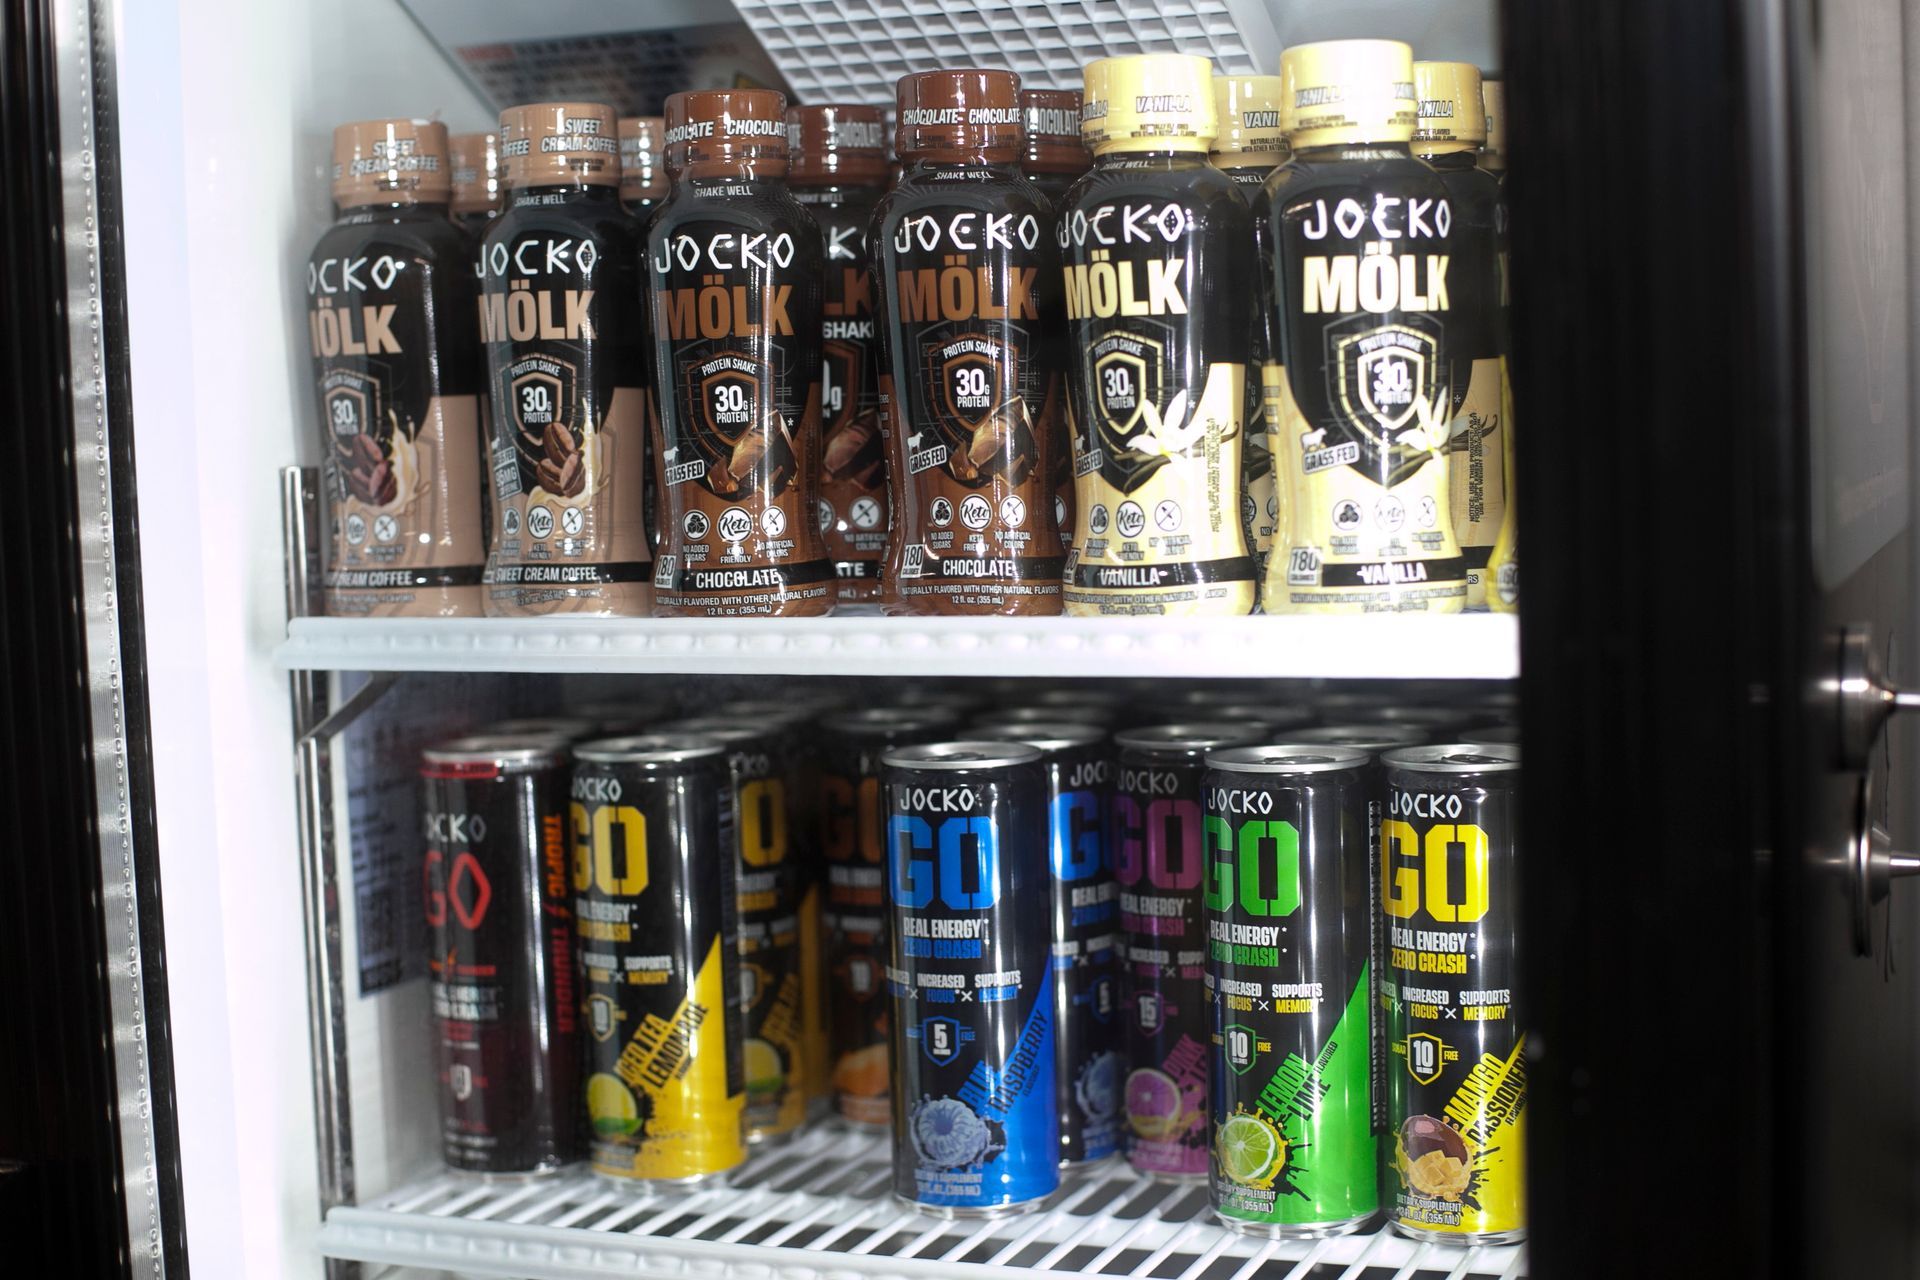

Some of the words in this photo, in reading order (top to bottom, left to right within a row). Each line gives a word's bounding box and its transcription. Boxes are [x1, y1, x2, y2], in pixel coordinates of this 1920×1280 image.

[1136, 95, 1192, 113] VANILLA
[1417, 101, 1453, 117] ANILLA
[565, 118, 602, 134] SWEET
[903, 109, 959, 125] CHOCOLATE
[969, 108, 1021, 124] CHOCOLATE
[541, 136, 583, 153] CREAM
[585, 136, 617, 154] COFFEE
[1126, 161, 1149, 169] WELL
[935, 172, 964, 180] SHAKE
[966, 171, 994, 179] WELL
[514, 196, 541, 207] SHAKE
[542, 194, 566, 205] WELL
[694, 187, 725, 198] SHAKE
[726, 185, 753, 196] WELL
[1060, 203, 1185, 248] JOCKO
[1303, 197, 1451, 240] JOCKO
[895, 213, 1039, 253] JOCKO
[474, 239, 598, 278] JOCKO
[655, 233, 795, 274] JOCKO
[1064, 249, 1188, 321] MÖLK
[1303, 241, 1449, 313] MÖLK
[897, 254, 1039, 323] MÖLK
[478, 279, 597, 344] MÖLK
[657, 274, 795, 341] MÖLK
[823, 321, 874, 339] SHAK
[943, 341, 974, 359] PROTEIN
[975, 341, 1001, 359] SHAKE
[1095, 338, 1118, 357] PROTEIN
[1119, 339, 1143, 355] SHAKE
[511, 360, 538, 377] PROTEIN
[539, 360, 561, 376] SHAKE
[701, 358, 732, 376] PROTEIN
[733, 358, 757, 375] SHAKE
[957, 395, 990, 408] PROTEIN
[1107, 396, 1135, 409] PROTEIN
[523, 411, 552, 424] PROTEIN
[717, 411, 749, 423] PROTEIN
[910, 453, 931, 472] GRASS
[931, 448, 946, 465] FED
[1305, 451, 1334, 471] GRASS
[1335, 445, 1356, 461] FED
[687, 463, 704, 480] FED
[962, 504, 992, 525] Keto
[1118, 509, 1142, 531] Keto
[530, 517, 553, 533] Keto
[721, 516, 752, 536] Keto
[937, 532, 954, 540] ADDED
[968, 534, 984, 543] KETO
[684, 553, 706, 562] SUGARS
[690, 545, 710, 553] ADDED
[905, 546, 922, 566] 180
[658, 556, 674, 576] 180
[720, 555, 752, 564] FRIENDLY
[943, 559, 1014, 577] CHOCOLATE
[368, 571, 413, 586] COFFEE
[496, 567, 523, 582] SWEET
[524, 566, 560, 581] CREAM
[561, 566, 599, 581] COFFEE
[696, 568, 781, 589] CHOCOLATE
[1100, 567, 1161, 586] VANILLA
[683, 596, 720, 606] FLAVORED
[721, 596, 741, 605] WITH
[743, 594, 769, 605] OTHER
[770, 591, 802, 603] NATURAL
[803, 587, 827, 599] FLAVORS
[934, 585, 962, 594] FLAVORED
[963, 585, 980, 593] WITH
[981, 585, 1003, 594] OTHER
[1003, 585, 1033, 594] NATURAL
[1034, 584, 1060, 594] FLAVORS
[706, 607, 716, 615] 12
[726, 607, 738, 615] oz.
[738, 605, 756, 615] (355
[976, 595, 991, 605] (355
[1117, 768, 1179, 794] JOCKO
[900, 787, 975, 811] JOCKO
[1208, 788, 1273, 815] JOCKO
[1390, 791, 1463, 818] JOCKO
[571, 802, 649, 896] GO
[1112, 796, 1203, 890] GO
[544, 815, 567, 898] TROPIC
[888, 814, 1001, 911] GO
[1204, 815, 1300, 917] GO
[1381, 818, 1489, 922] GO
[424, 851, 492, 929] GO
[1141, 895, 1185, 917] ENERGY
[904, 917, 930, 938] REAL
[931, 919, 981, 939] ENERGY
[1211, 920, 1231, 943] REAL
[1232, 924, 1280, 946] ENERGY
[904, 937, 932, 958] ZERO
[934, 939, 982, 959] CRASH
[1392, 927, 1415, 949] REAL
[1416, 930, 1467, 953] ENERGY
[624, 955, 673, 970] SUPPORTS
[1233, 945, 1280, 968] CRASH
[1392, 948, 1416, 970] ZERO
[1418, 953, 1467, 974] CRASH
[628, 971, 668, 985] MEMORY
[917, 973, 965, 988] INCREASED
[975, 970, 1021, 988] SUPPORTS
[1220, 978, 1262, 997] INCREASED
[1272, 983, 1323, 998] SUPPORTS
[926, 988, 955, 1003] FOCUS
[1227, 995, 1252, 1011] FOCUS
[1276, 999, 1319, 1014] MEMORY
[1403, 986, 1450, 1006] INCREASED
[1460, 989, 1511, 1006] SUPPORTS
[1411, 1004, 1439, 1020] FOCUS
[1464, 1005, 1507, 1021] MEMORY
[632, 1011, 669, 1048] TEA
[934, 1023, 949, 1049] 5
[642, 1000, 709, 1089] LEMONADE
[1229, 1031, 1248, 1059] 10
[1257, 1041, 1272, 1053] FREE
[1413, 1040, 1434, 1068] 10
[986, 1010, 1048, 1115] RASPBERRY
[1314, 1041, 1338, 1075] FLAVORED
[1443, 1050, 1459, 1061] FREE
[1255, 1051, 1312, 1118] LEMON
[1443, 1052, 1506, 1123] MANGO
[1286, 1073, 1331, 1122] LIME
[1234, 1186, 1276, 1201] SUPPLEMENT
[1242, 1199, 1258, 1211] (355
[1419, 1199, 1463, 1212] SUPPLEMENT
[1425, 1211, 1443, 1223] (355
[1443, 1213, 1460, 1226] ML)
